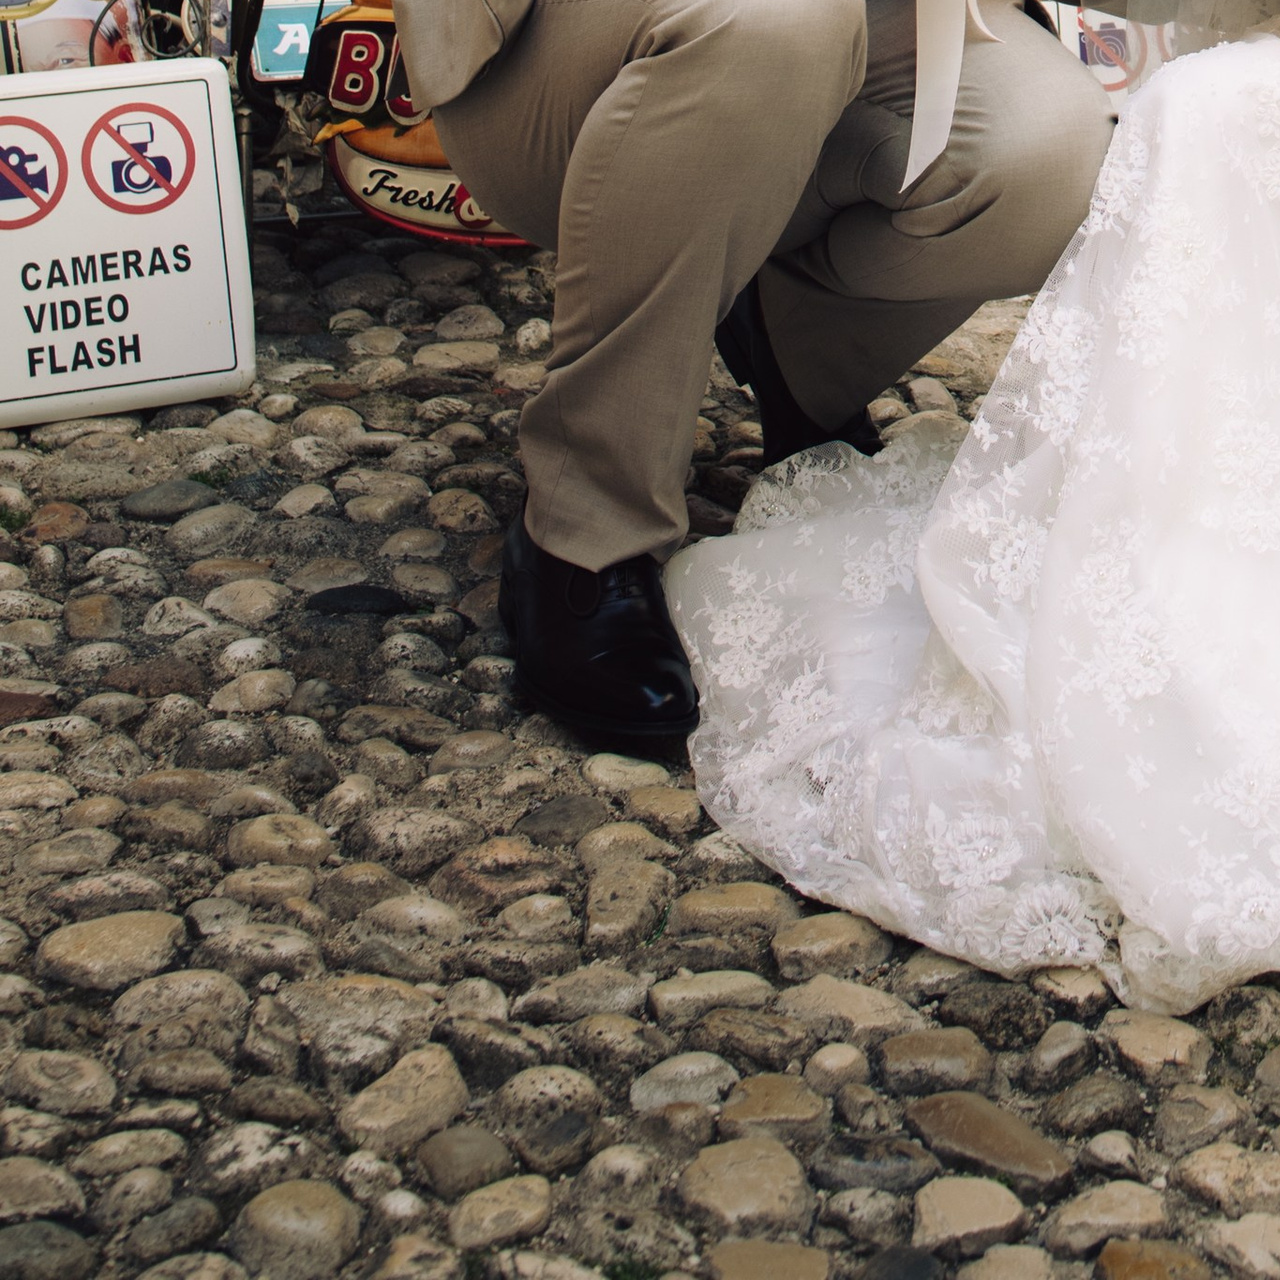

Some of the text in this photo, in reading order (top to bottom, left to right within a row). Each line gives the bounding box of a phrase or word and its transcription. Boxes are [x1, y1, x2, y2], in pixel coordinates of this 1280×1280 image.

[362, 169, 457, 214] Fresh
[20, 244, 193, 292] CAMERAS
[23, 292, 130, 334] VIDEO
[26, 333, 142, 378] FLASH
